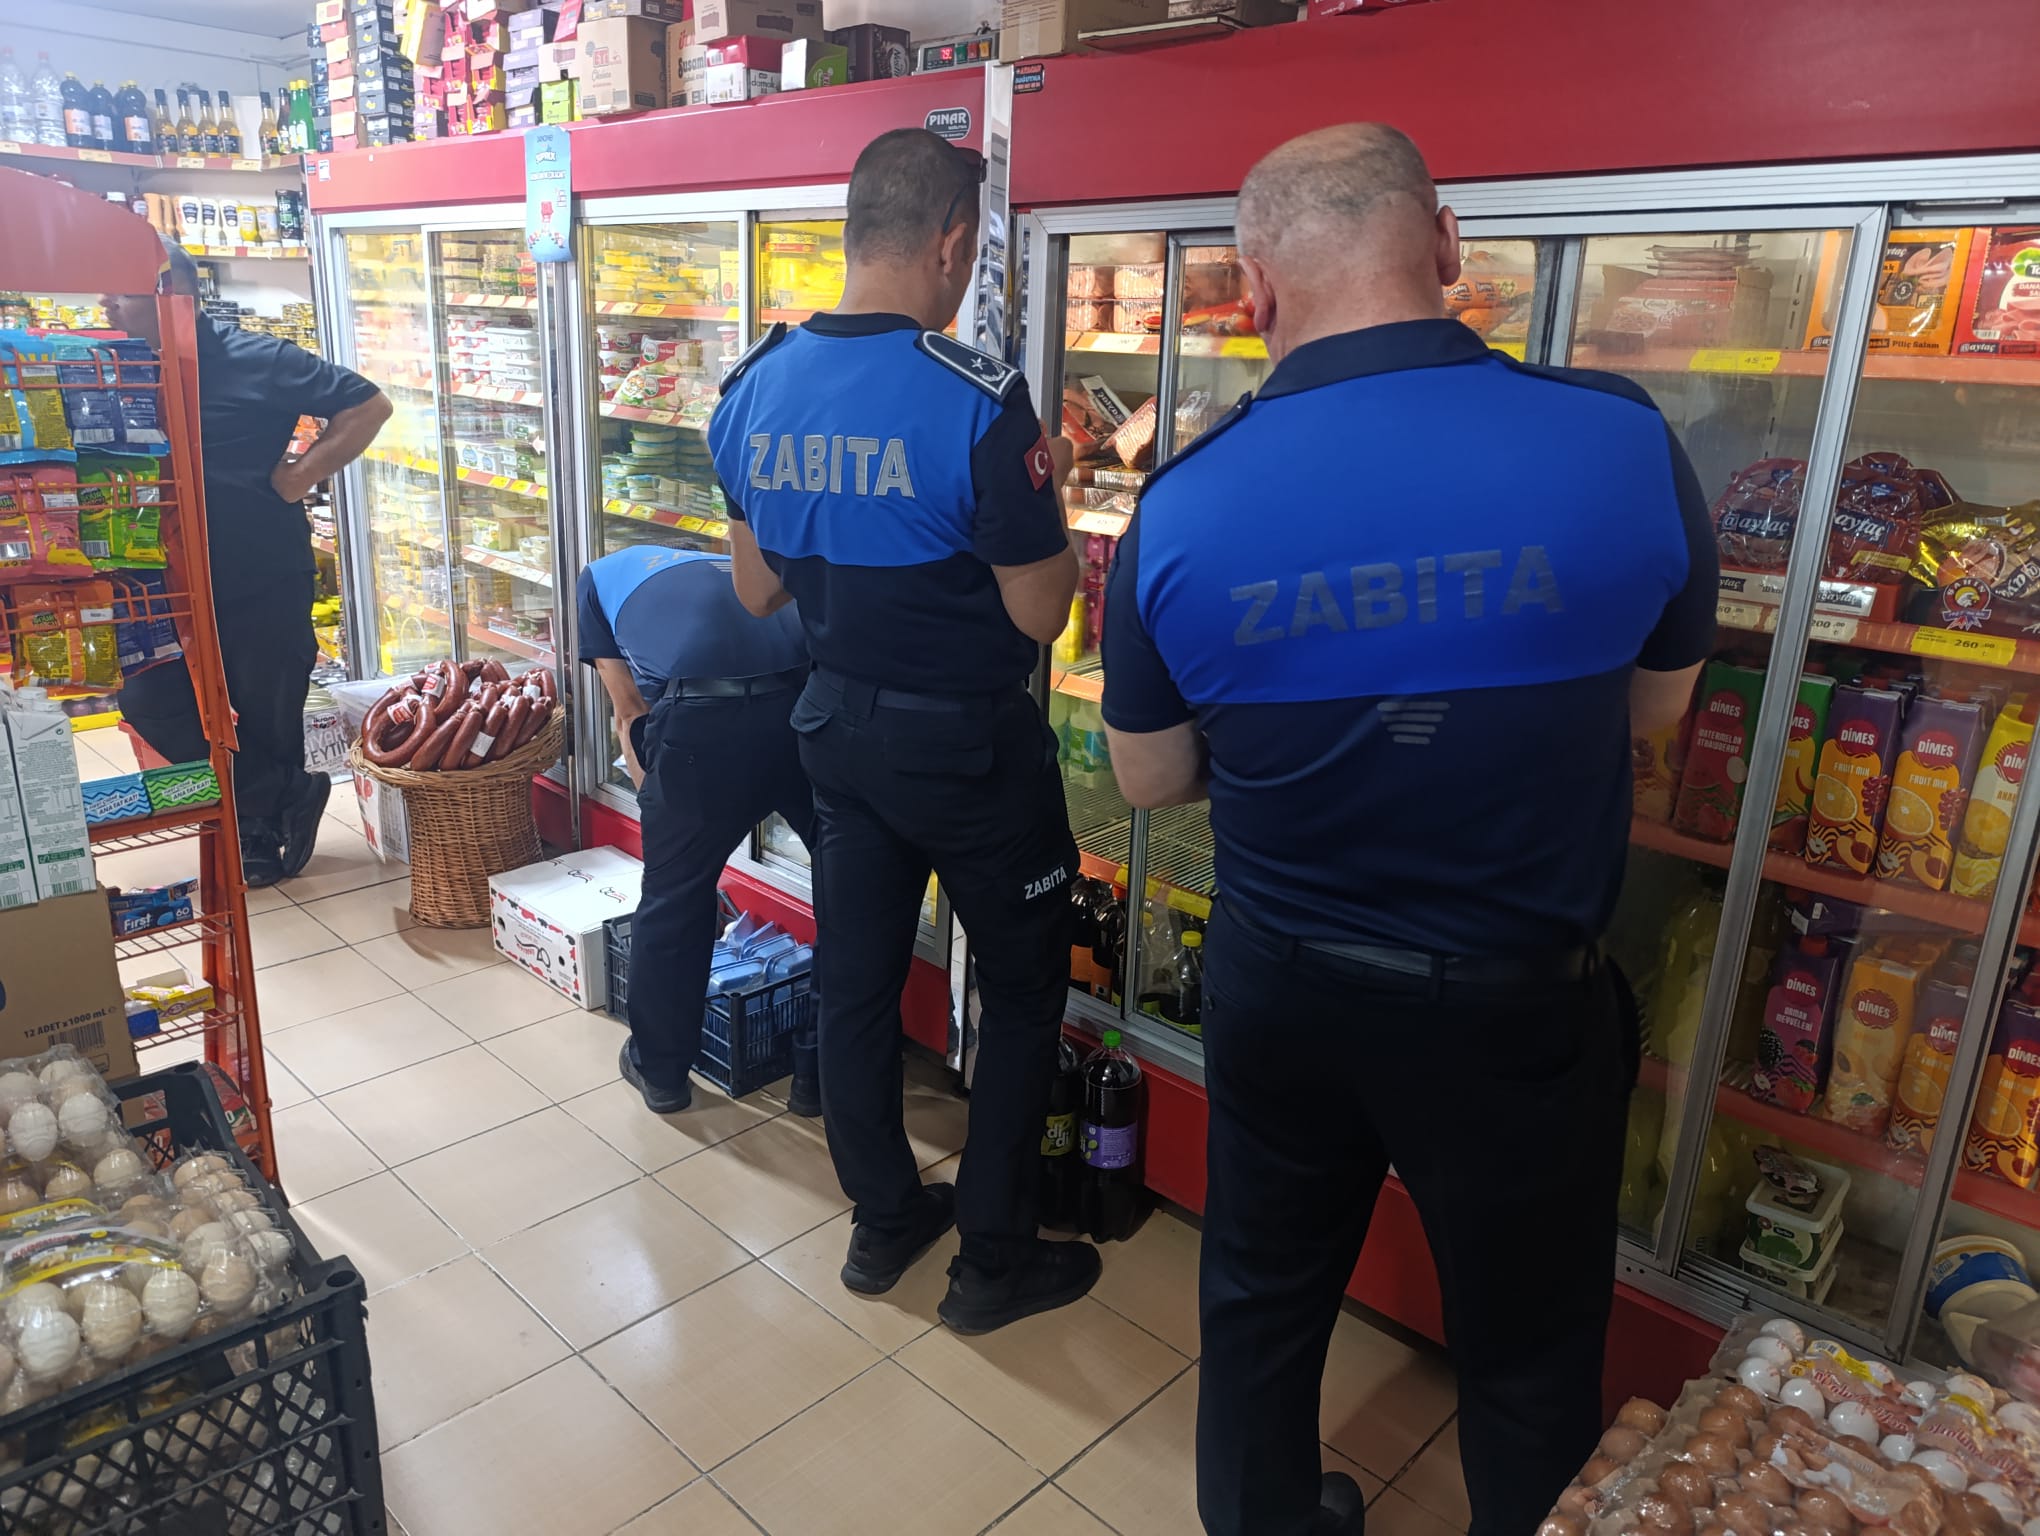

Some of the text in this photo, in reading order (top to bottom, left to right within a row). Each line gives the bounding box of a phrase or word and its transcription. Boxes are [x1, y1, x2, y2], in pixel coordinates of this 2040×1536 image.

[929, 113, 967, 126] PINAR
[1892, 339, 1912, 351] Piliç
[1914, 341, 1939, 349] Salam
[749, 433, 916, 498] ZABITA
[1739, 519, 1790, 537] aytaç
[1834, 512, 1886, 541] aytaç
[1229, 544, 1565, 647] ZABITA
[1954, 639, 1979, 649] 260
[1710, 699, 1741, 718] DİMES
[1698, 729, 1742, 744] WATERMELON
[1840, 727, 1875, 746] DİMES
[1697, 738, 1739, 754] STRAWBERRY
[1917, 739, 1954, 758] DİMES
[1833, 762, 1854, 775] FRUIT
[1908, 774, 1931, 786] FRUIT
[1024, 866, 1067, 900] ZABITA
[176, 906, 190, 917] 60
[123, 913, 152, 931] First
[1786, 977, 1817, 997] DİMES
[1784, 1006, 1808, 1020] ORMAN
[1858, 999, 1890, 1019] DİMES
[24, 1030, 35, 1038] 12
[38, 1021, 61, 1035] ADET
